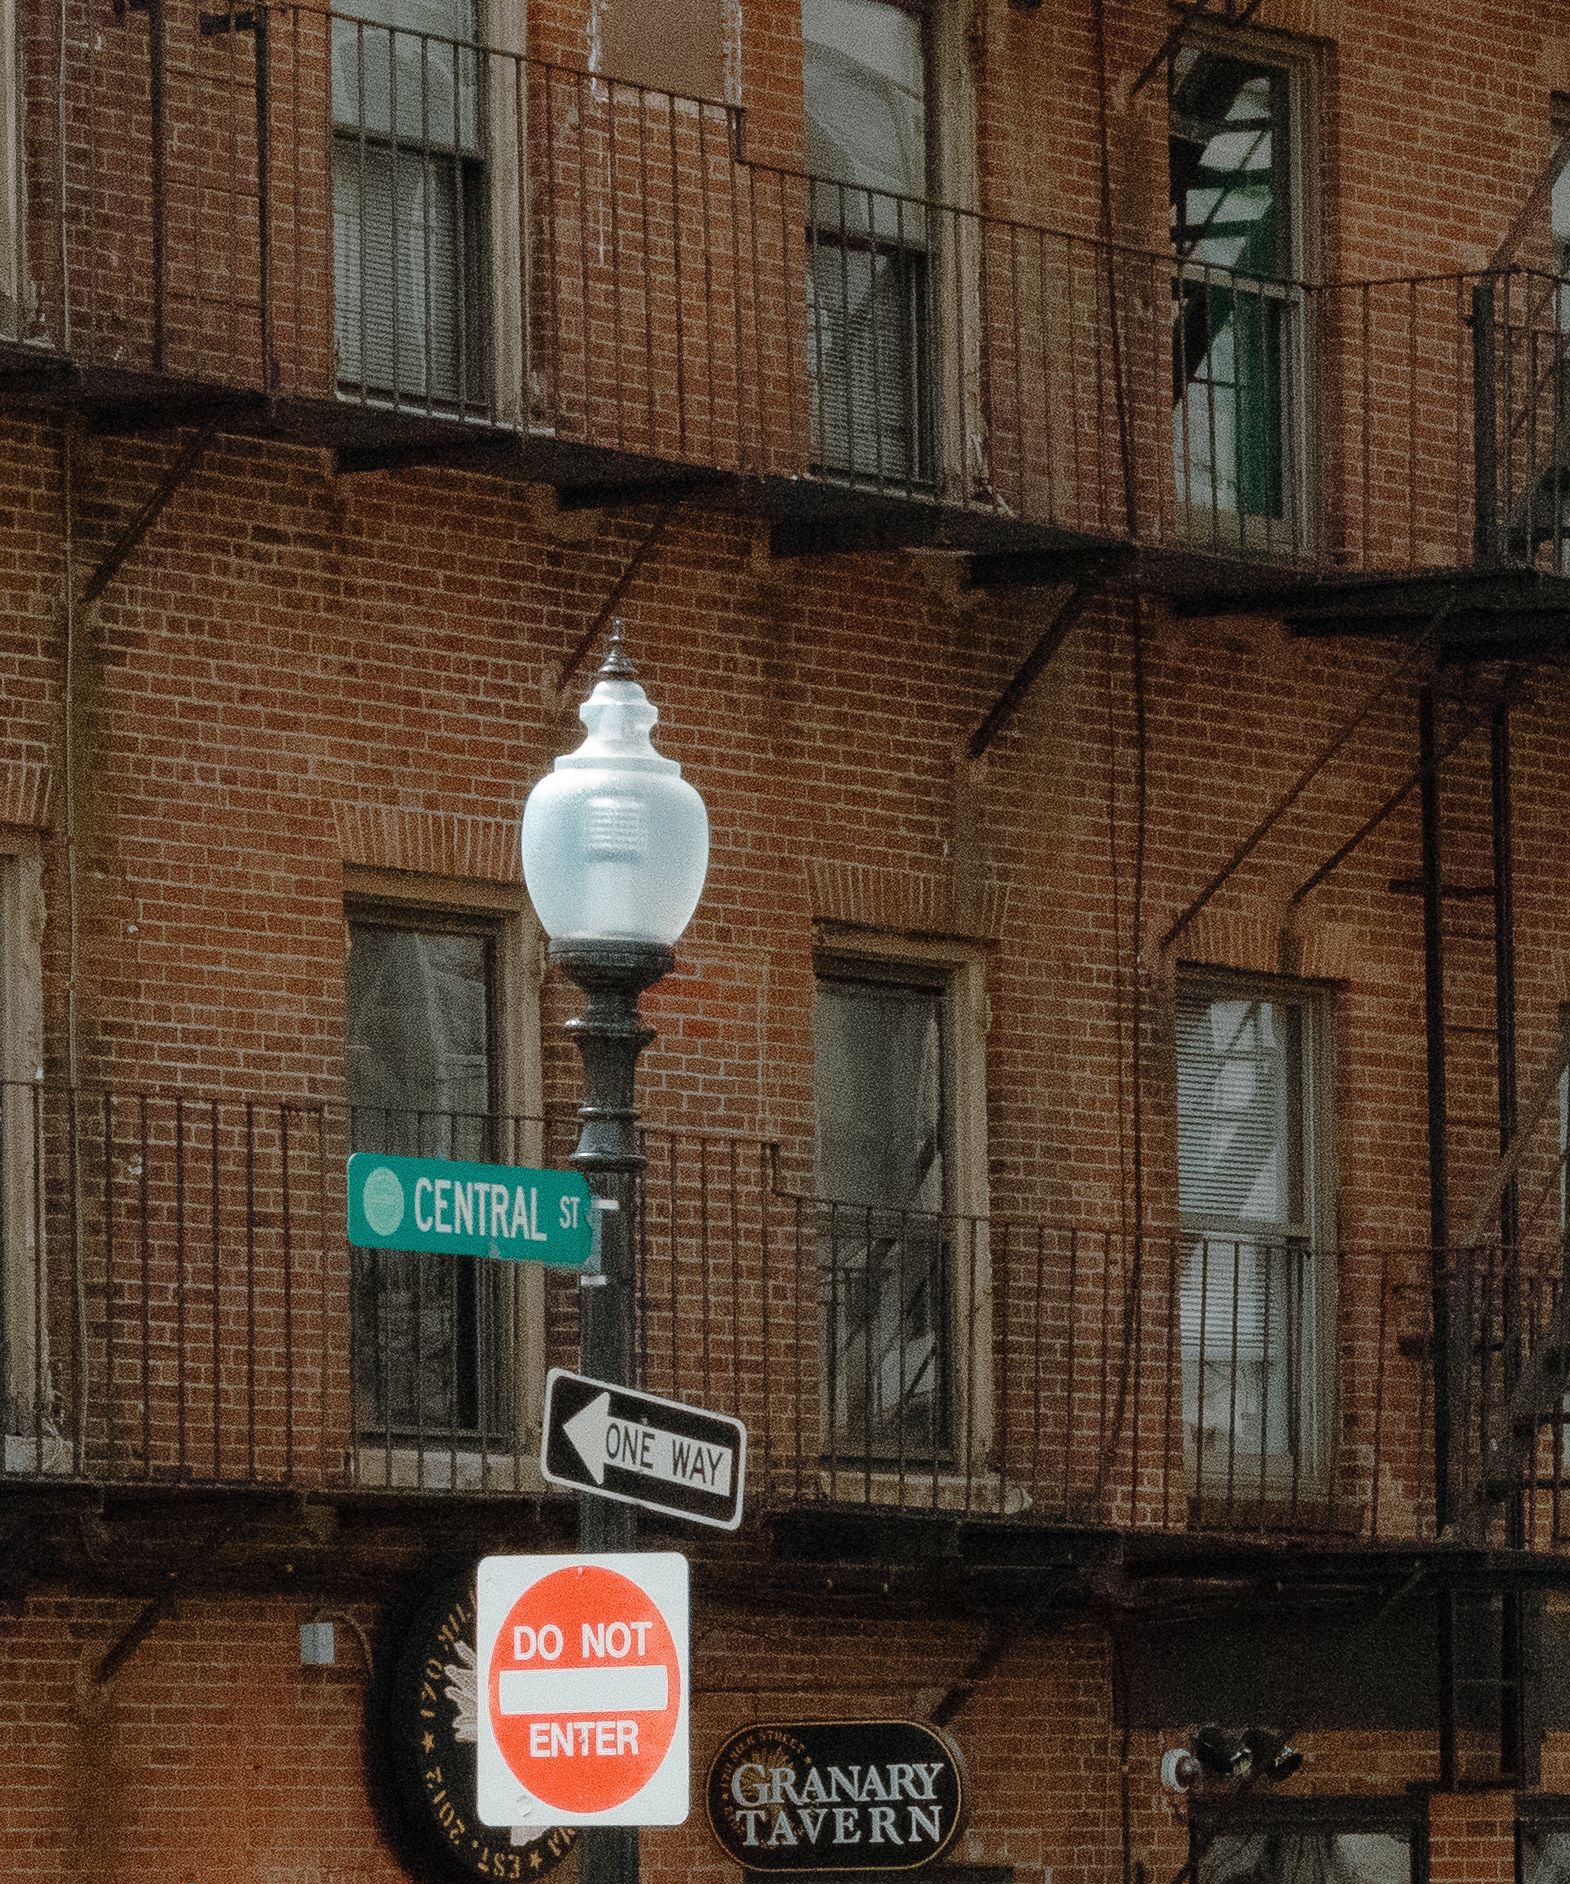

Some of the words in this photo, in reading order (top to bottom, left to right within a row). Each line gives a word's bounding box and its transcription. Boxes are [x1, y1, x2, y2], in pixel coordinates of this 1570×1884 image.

[414, 1177, 548, 1241] CENTRAL
[558, 1196, 580, 1229] ST
[606, 1422, 655, 1471] ONE
[671, 1438, 724, 1487] WAY
[513, 1625, 564, 1661] DO
[581, 1620, 653, 1659] NOT
[529, 1719, 640, 1759] ENTER
[425, 1766, 466, 1846] 2012
[731, 1763, 945, 1807] GRANARY
[735, 1806, 943, 1847] TAVERN
